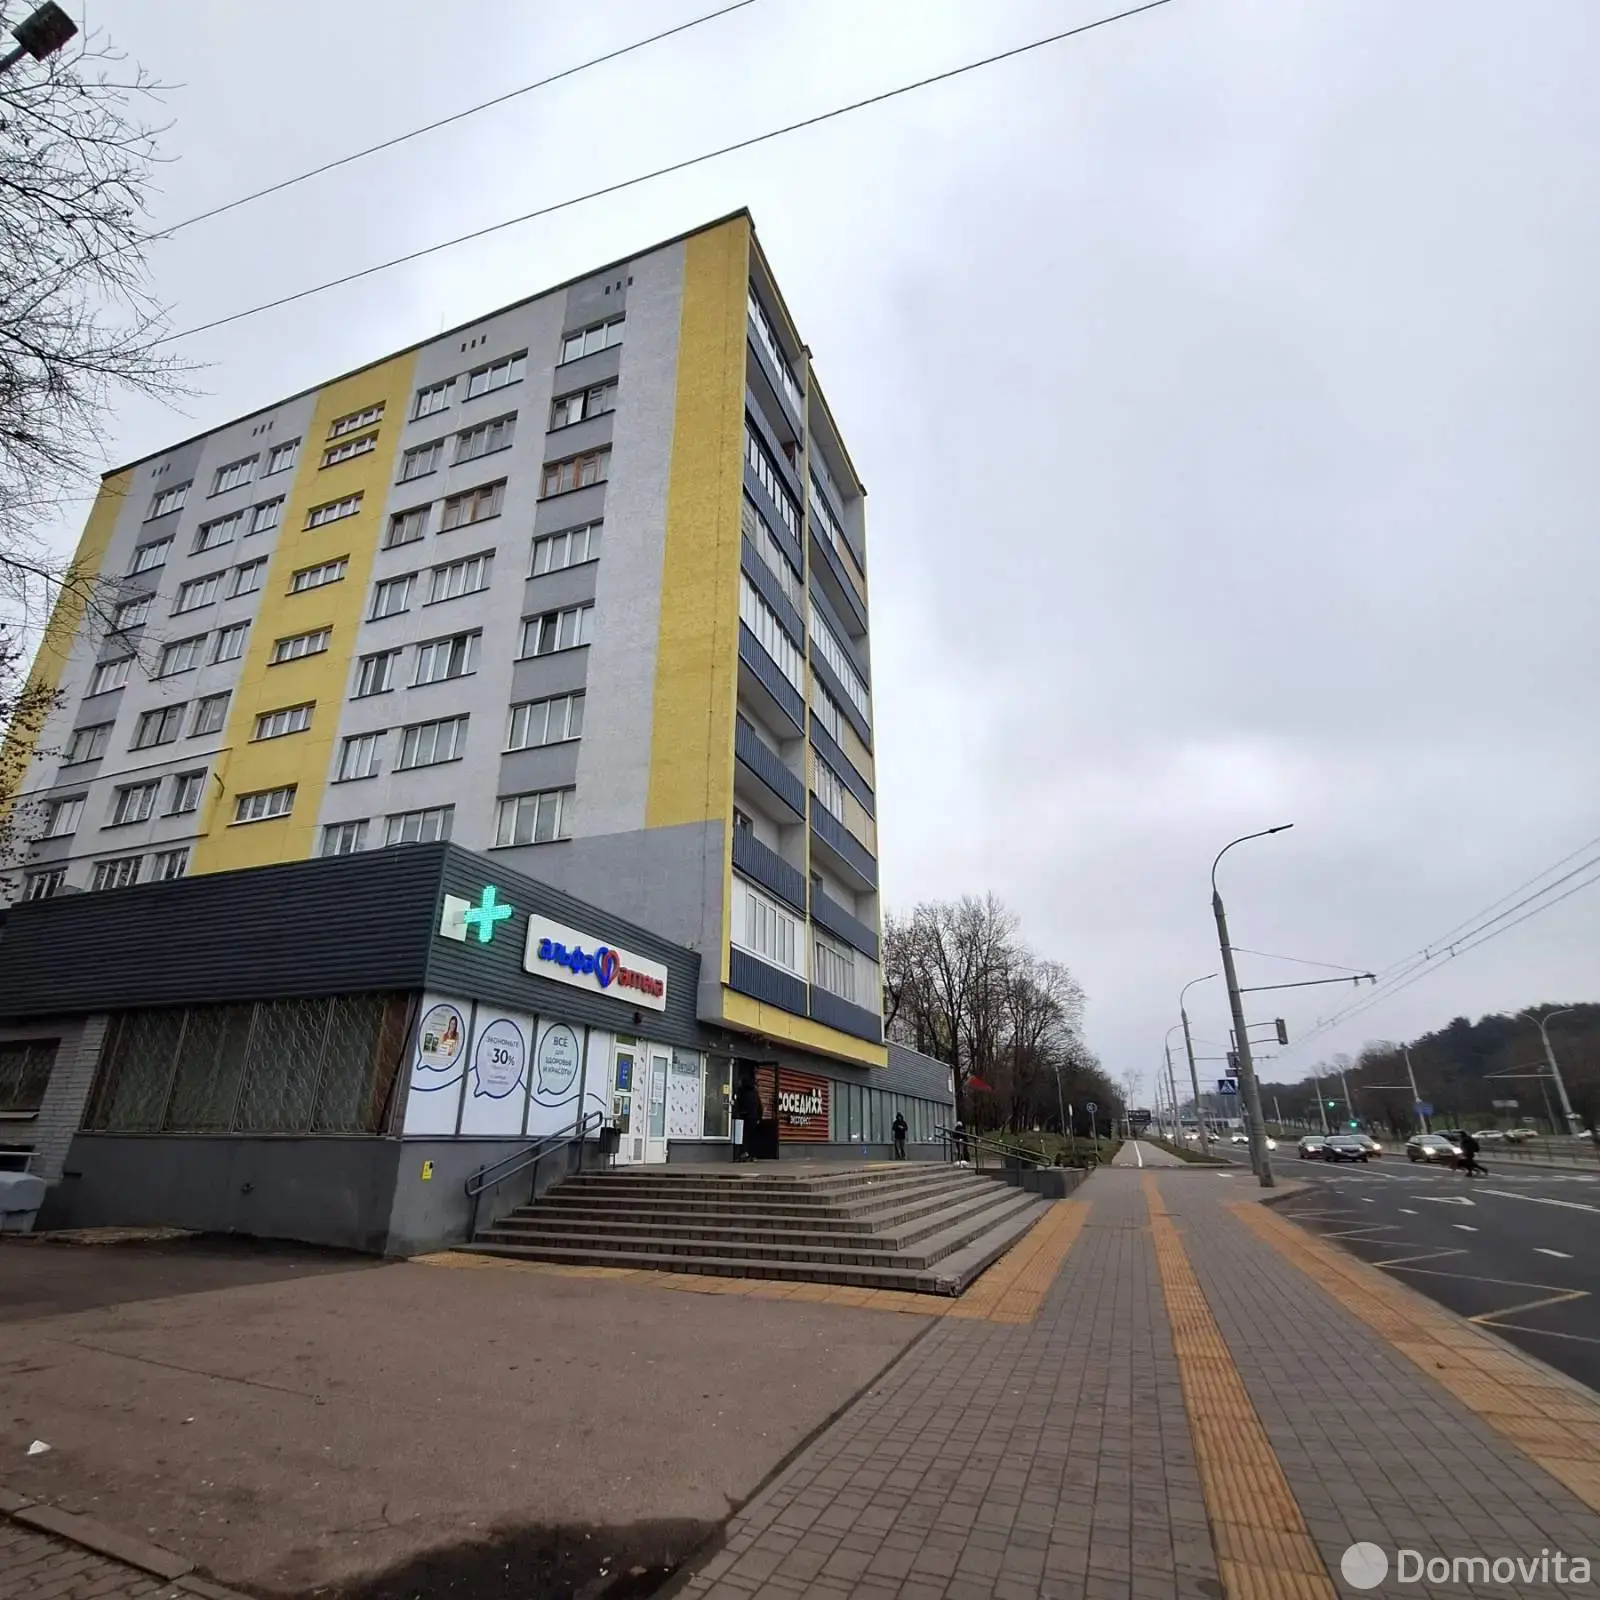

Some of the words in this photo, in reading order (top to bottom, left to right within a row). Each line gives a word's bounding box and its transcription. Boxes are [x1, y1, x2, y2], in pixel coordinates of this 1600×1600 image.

[537, 938, 595, 975] альфа
[617, 967, 664, 998] аптека
[491, 1047, 515, 1066] 30%
